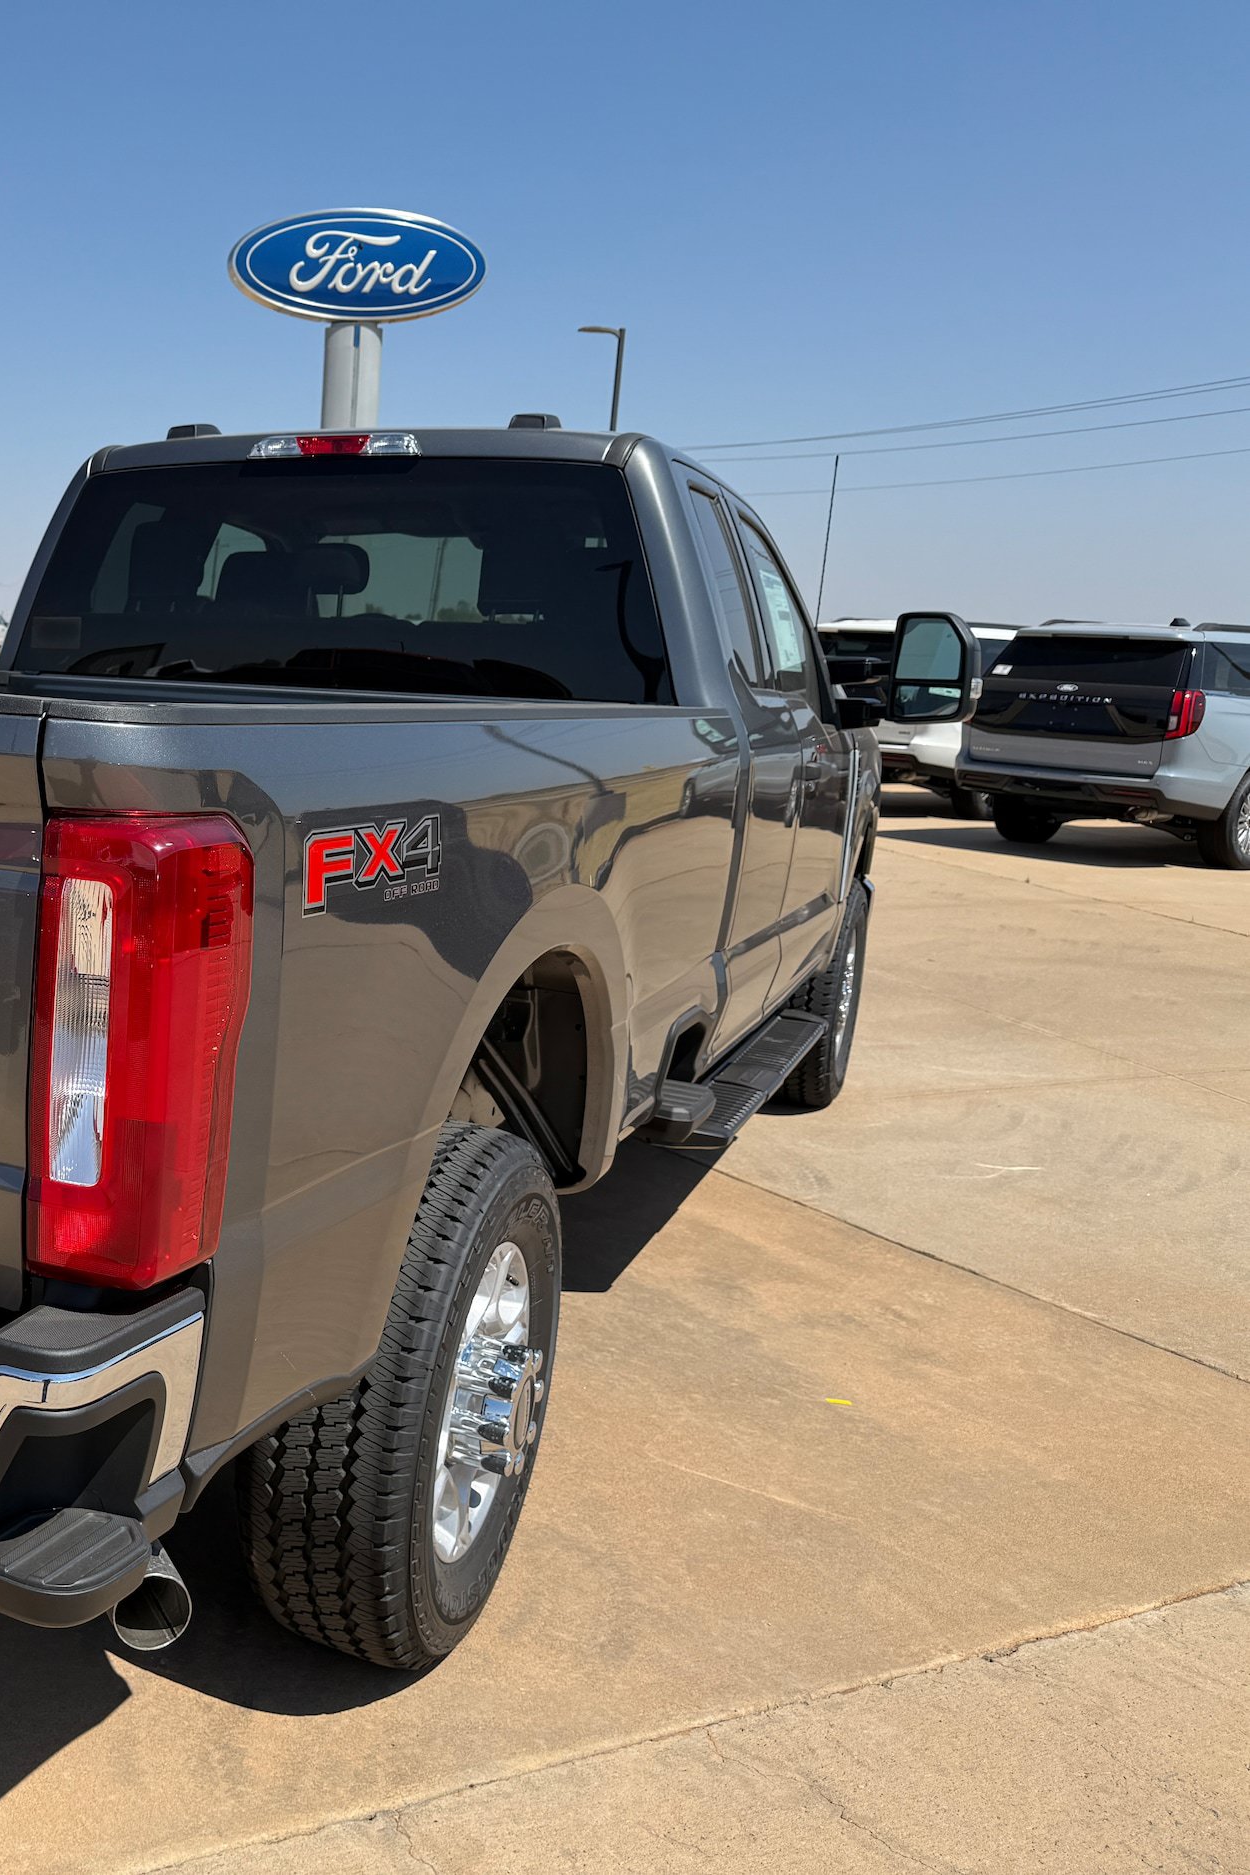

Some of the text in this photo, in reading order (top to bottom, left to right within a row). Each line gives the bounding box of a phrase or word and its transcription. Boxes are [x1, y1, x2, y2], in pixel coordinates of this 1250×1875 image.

[289, 230, 437, 295] Ford
[1018, 692, 1112, 704] EXPEDITION
[302, 813, 442, 918] FX4
[383, 878, 440, 901] OFF ROAD
